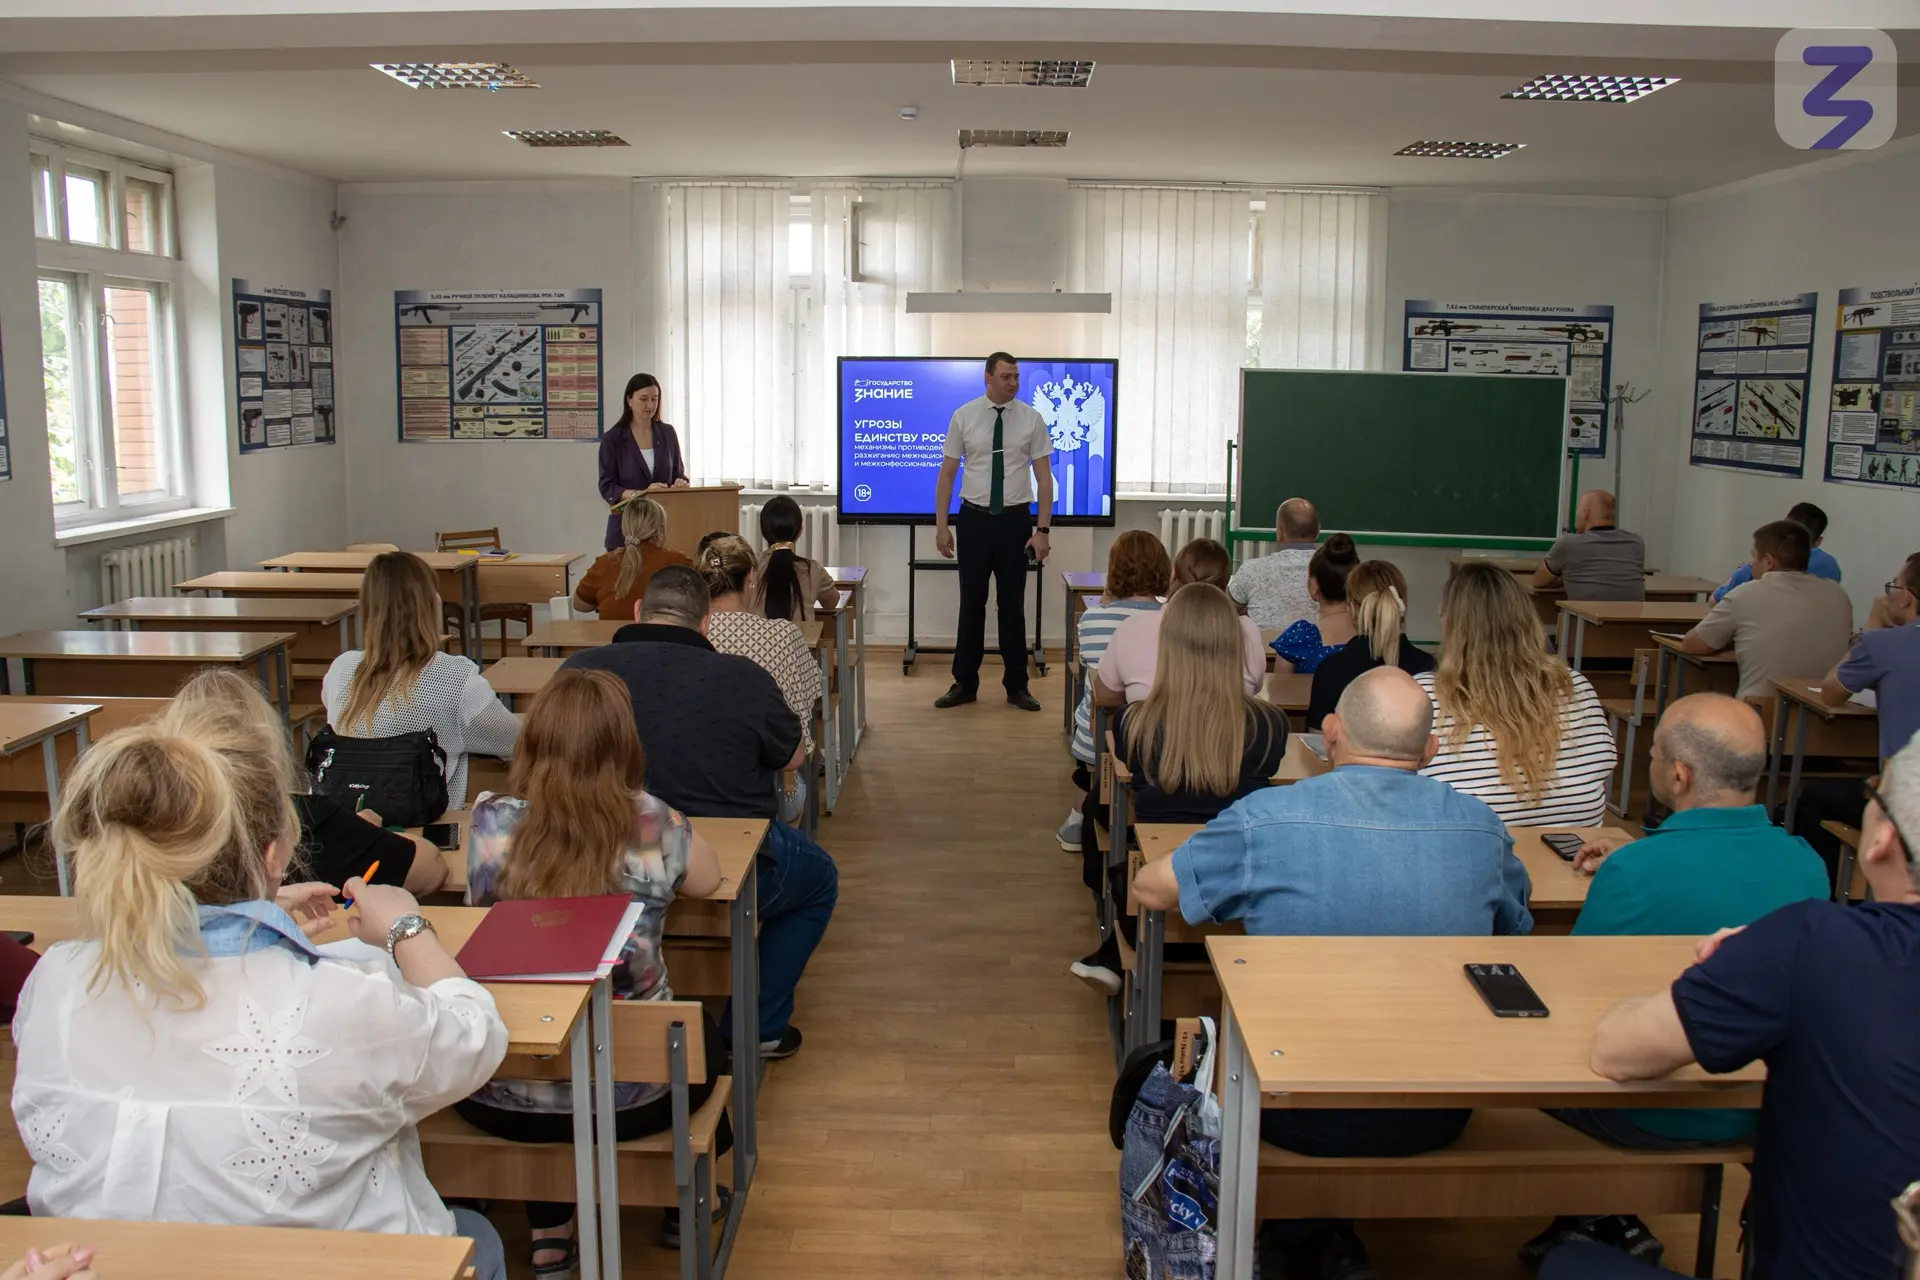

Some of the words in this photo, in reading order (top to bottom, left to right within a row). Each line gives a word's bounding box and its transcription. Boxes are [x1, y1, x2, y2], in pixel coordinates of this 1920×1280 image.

[1870, 286, 1915, 300] ПОДСТВОЛЬНЫЙ
[854, 420, 903, 429] УГРОЗЫ
[854, 433, 919, 443] ЕДИНСТВУ
[921, 433, 946, 443] РОС
[898, 443, 944, 451] противодей
[854, 452, 901, 460] разжиганию
[901, 452, 945, 460] межнацион
[860, 460, 942, 468] межконфессионально
[858, 488, 870, 498] 18+
[1170, 1199, 1195, 1220] cky
